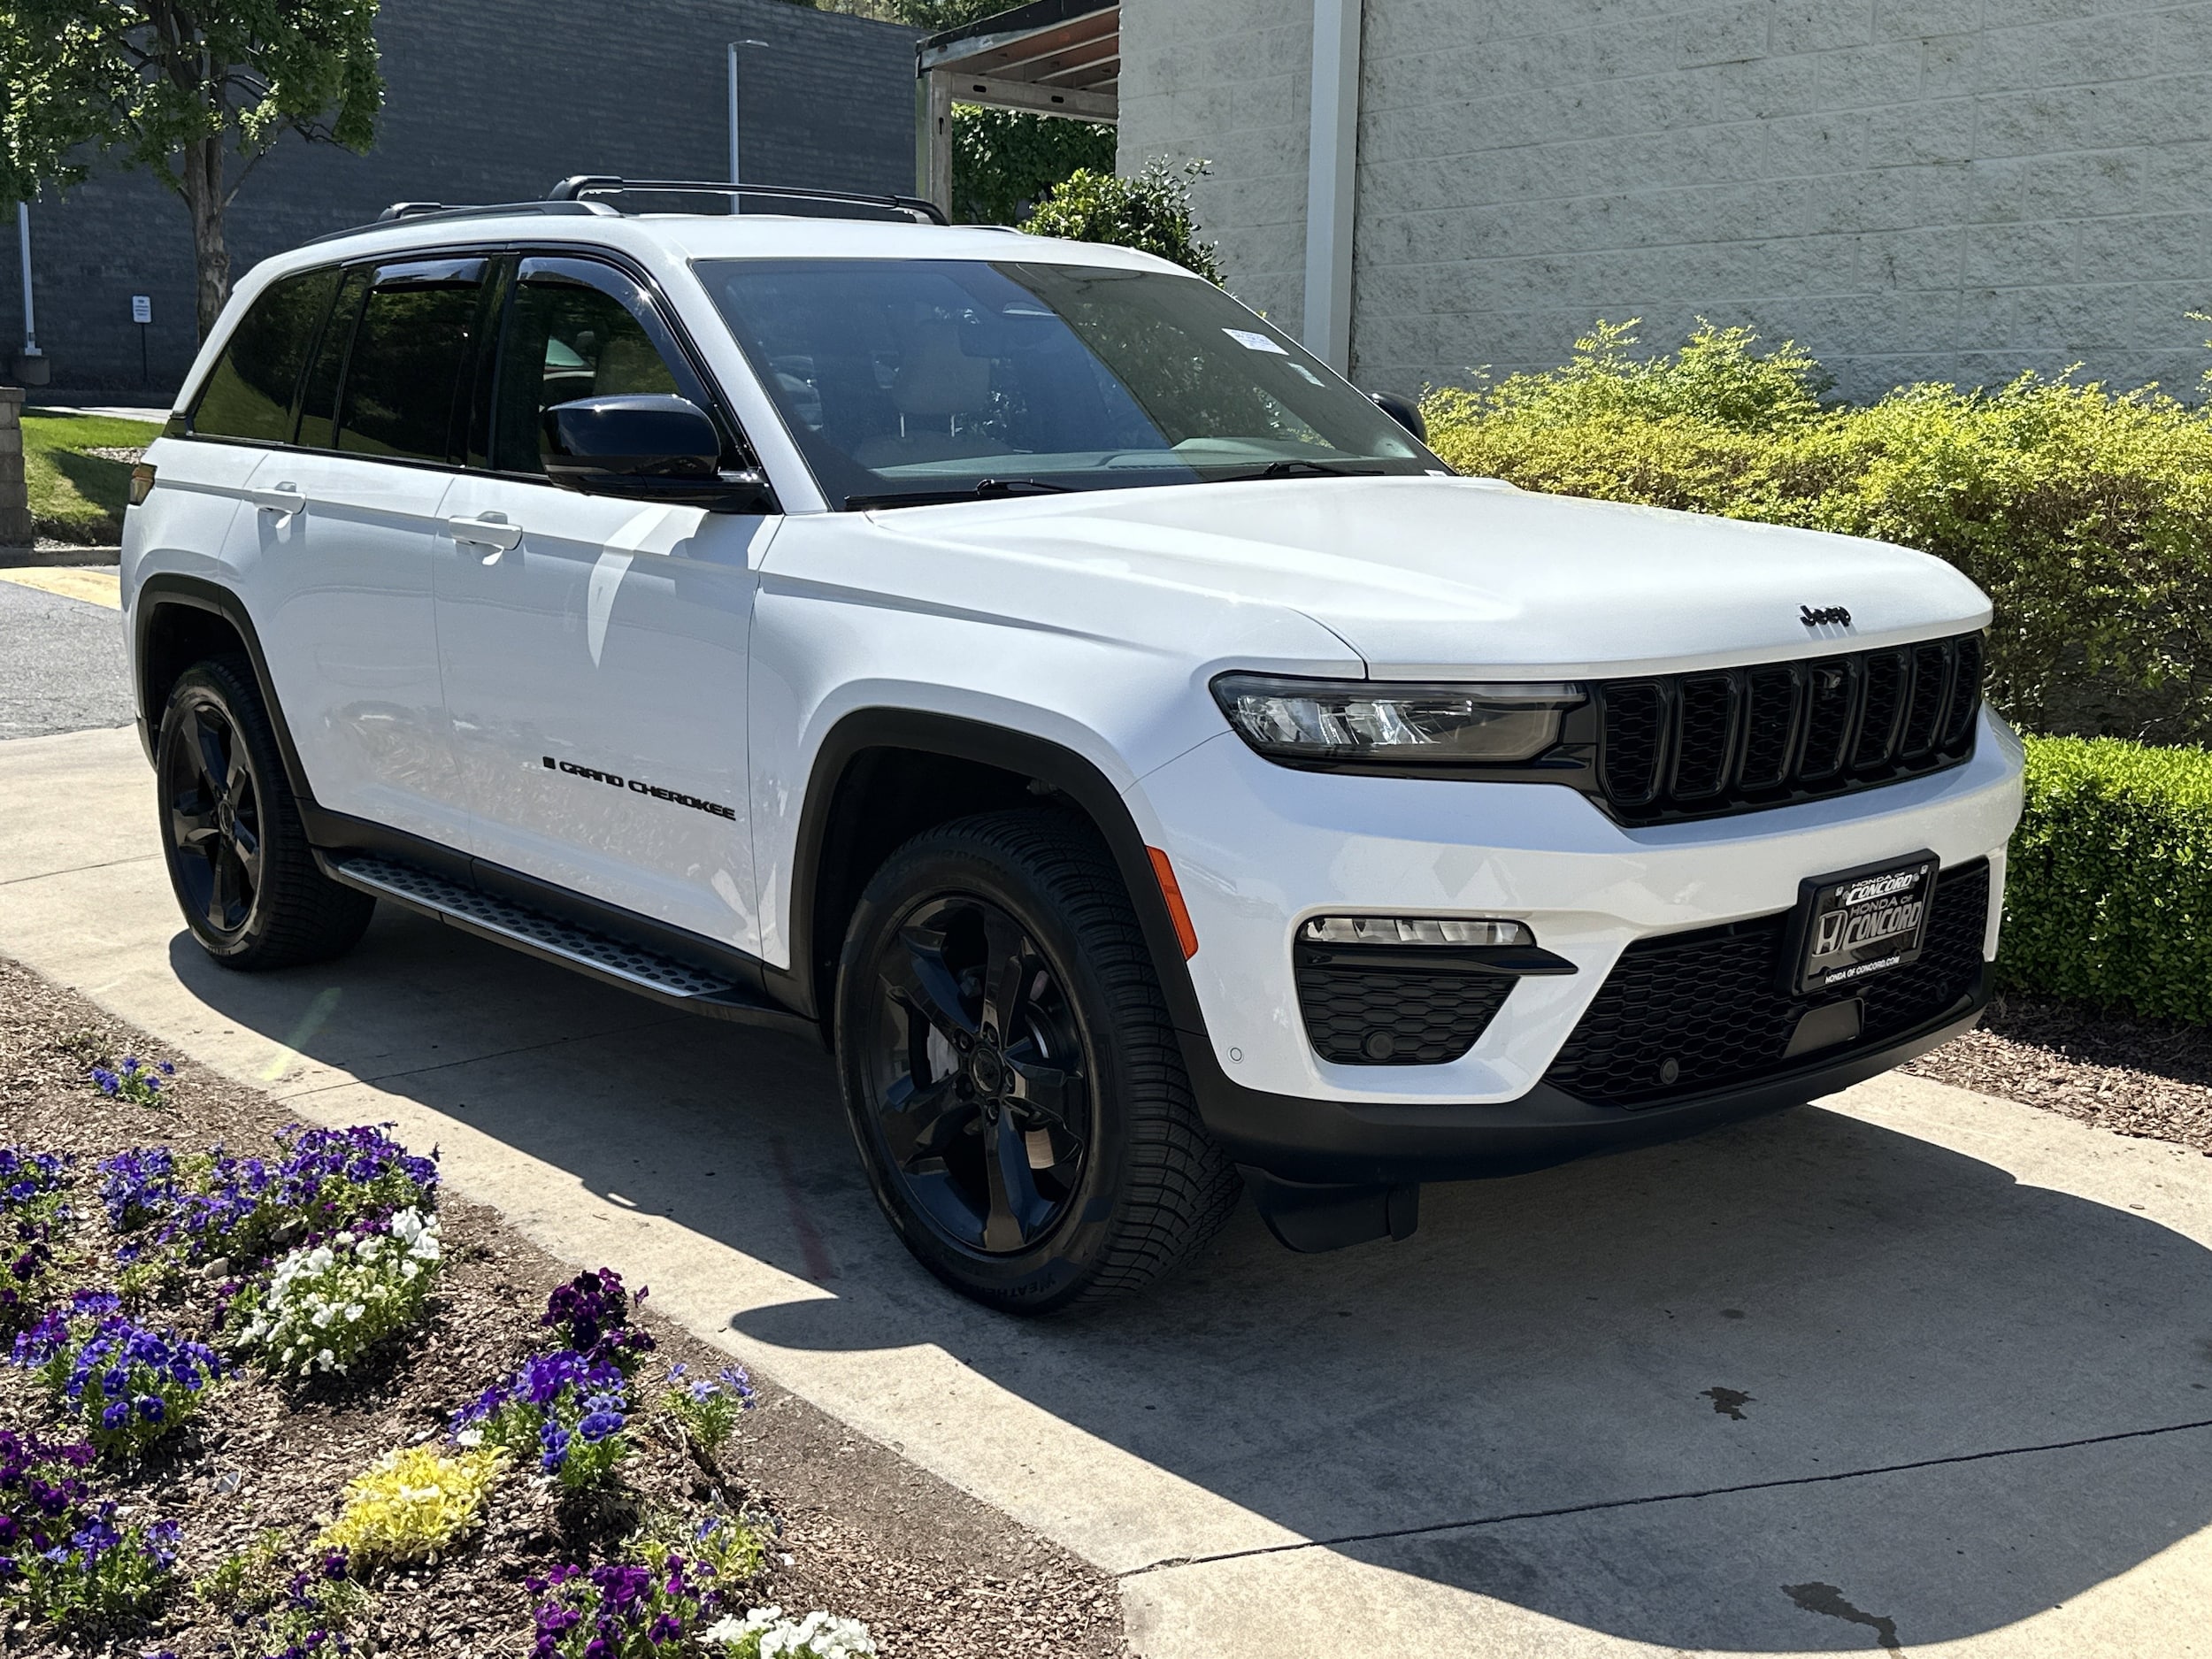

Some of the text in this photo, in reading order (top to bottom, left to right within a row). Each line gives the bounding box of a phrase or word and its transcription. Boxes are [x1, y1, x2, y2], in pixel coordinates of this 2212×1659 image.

[1800, 604, 1851, 627] Jeep
[559, 761, 736, 821] GRAND CHEROKEE
[1845, 873, 1913, 906] CONCORD
[1851, 874, 1892, 888] HONDA
[1849, 894, 1914, 918] HONDA OF
[1842, 901, 1922, 950] CONCORD
[1824, 971, 1847, 984] HONDA
[1847, 968, 1856, 978] OF
